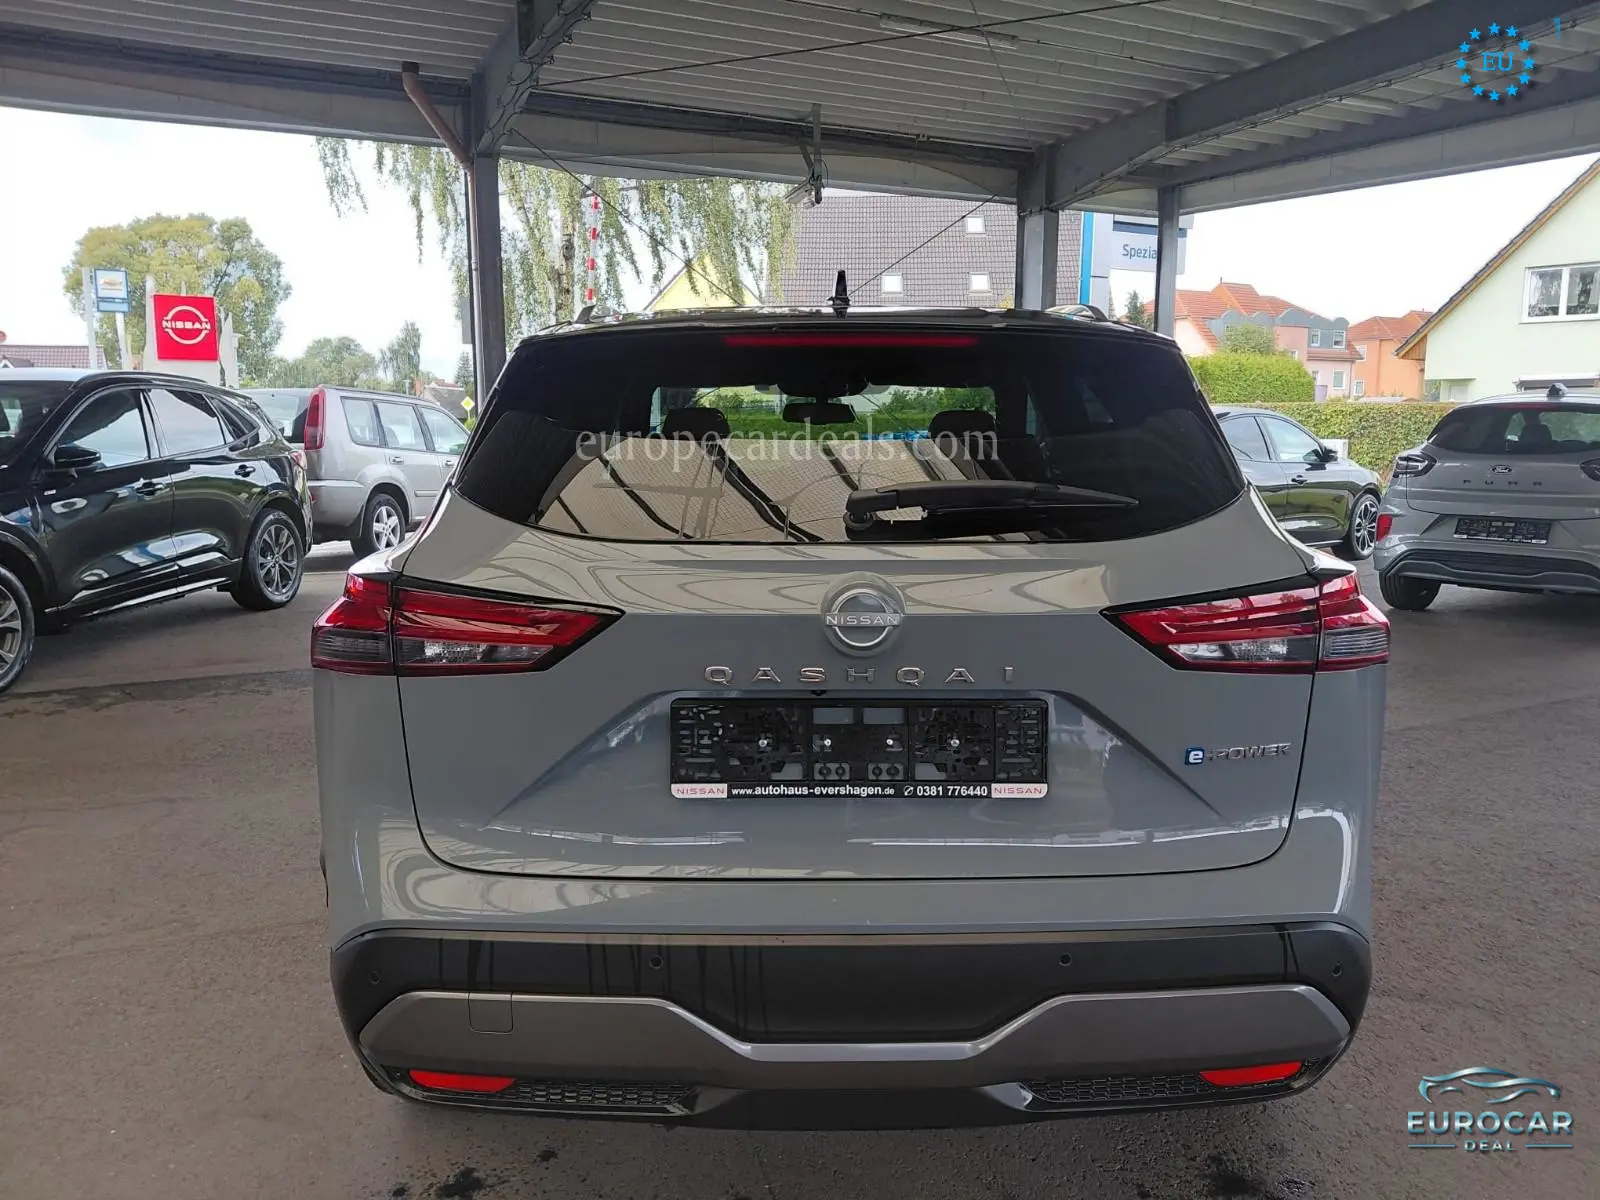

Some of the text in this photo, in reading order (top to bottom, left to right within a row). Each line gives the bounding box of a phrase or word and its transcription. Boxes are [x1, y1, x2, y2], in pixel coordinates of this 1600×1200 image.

[162, 319, 211, 330] NISSAN
[825, 613, 900, 626] NISSAN
[703, 665, 1016, 687] QASHQAI
[676, 784, 1043, 797] NISSAN www.autohaus-evershagen.de 0381 776440 NISSAN
